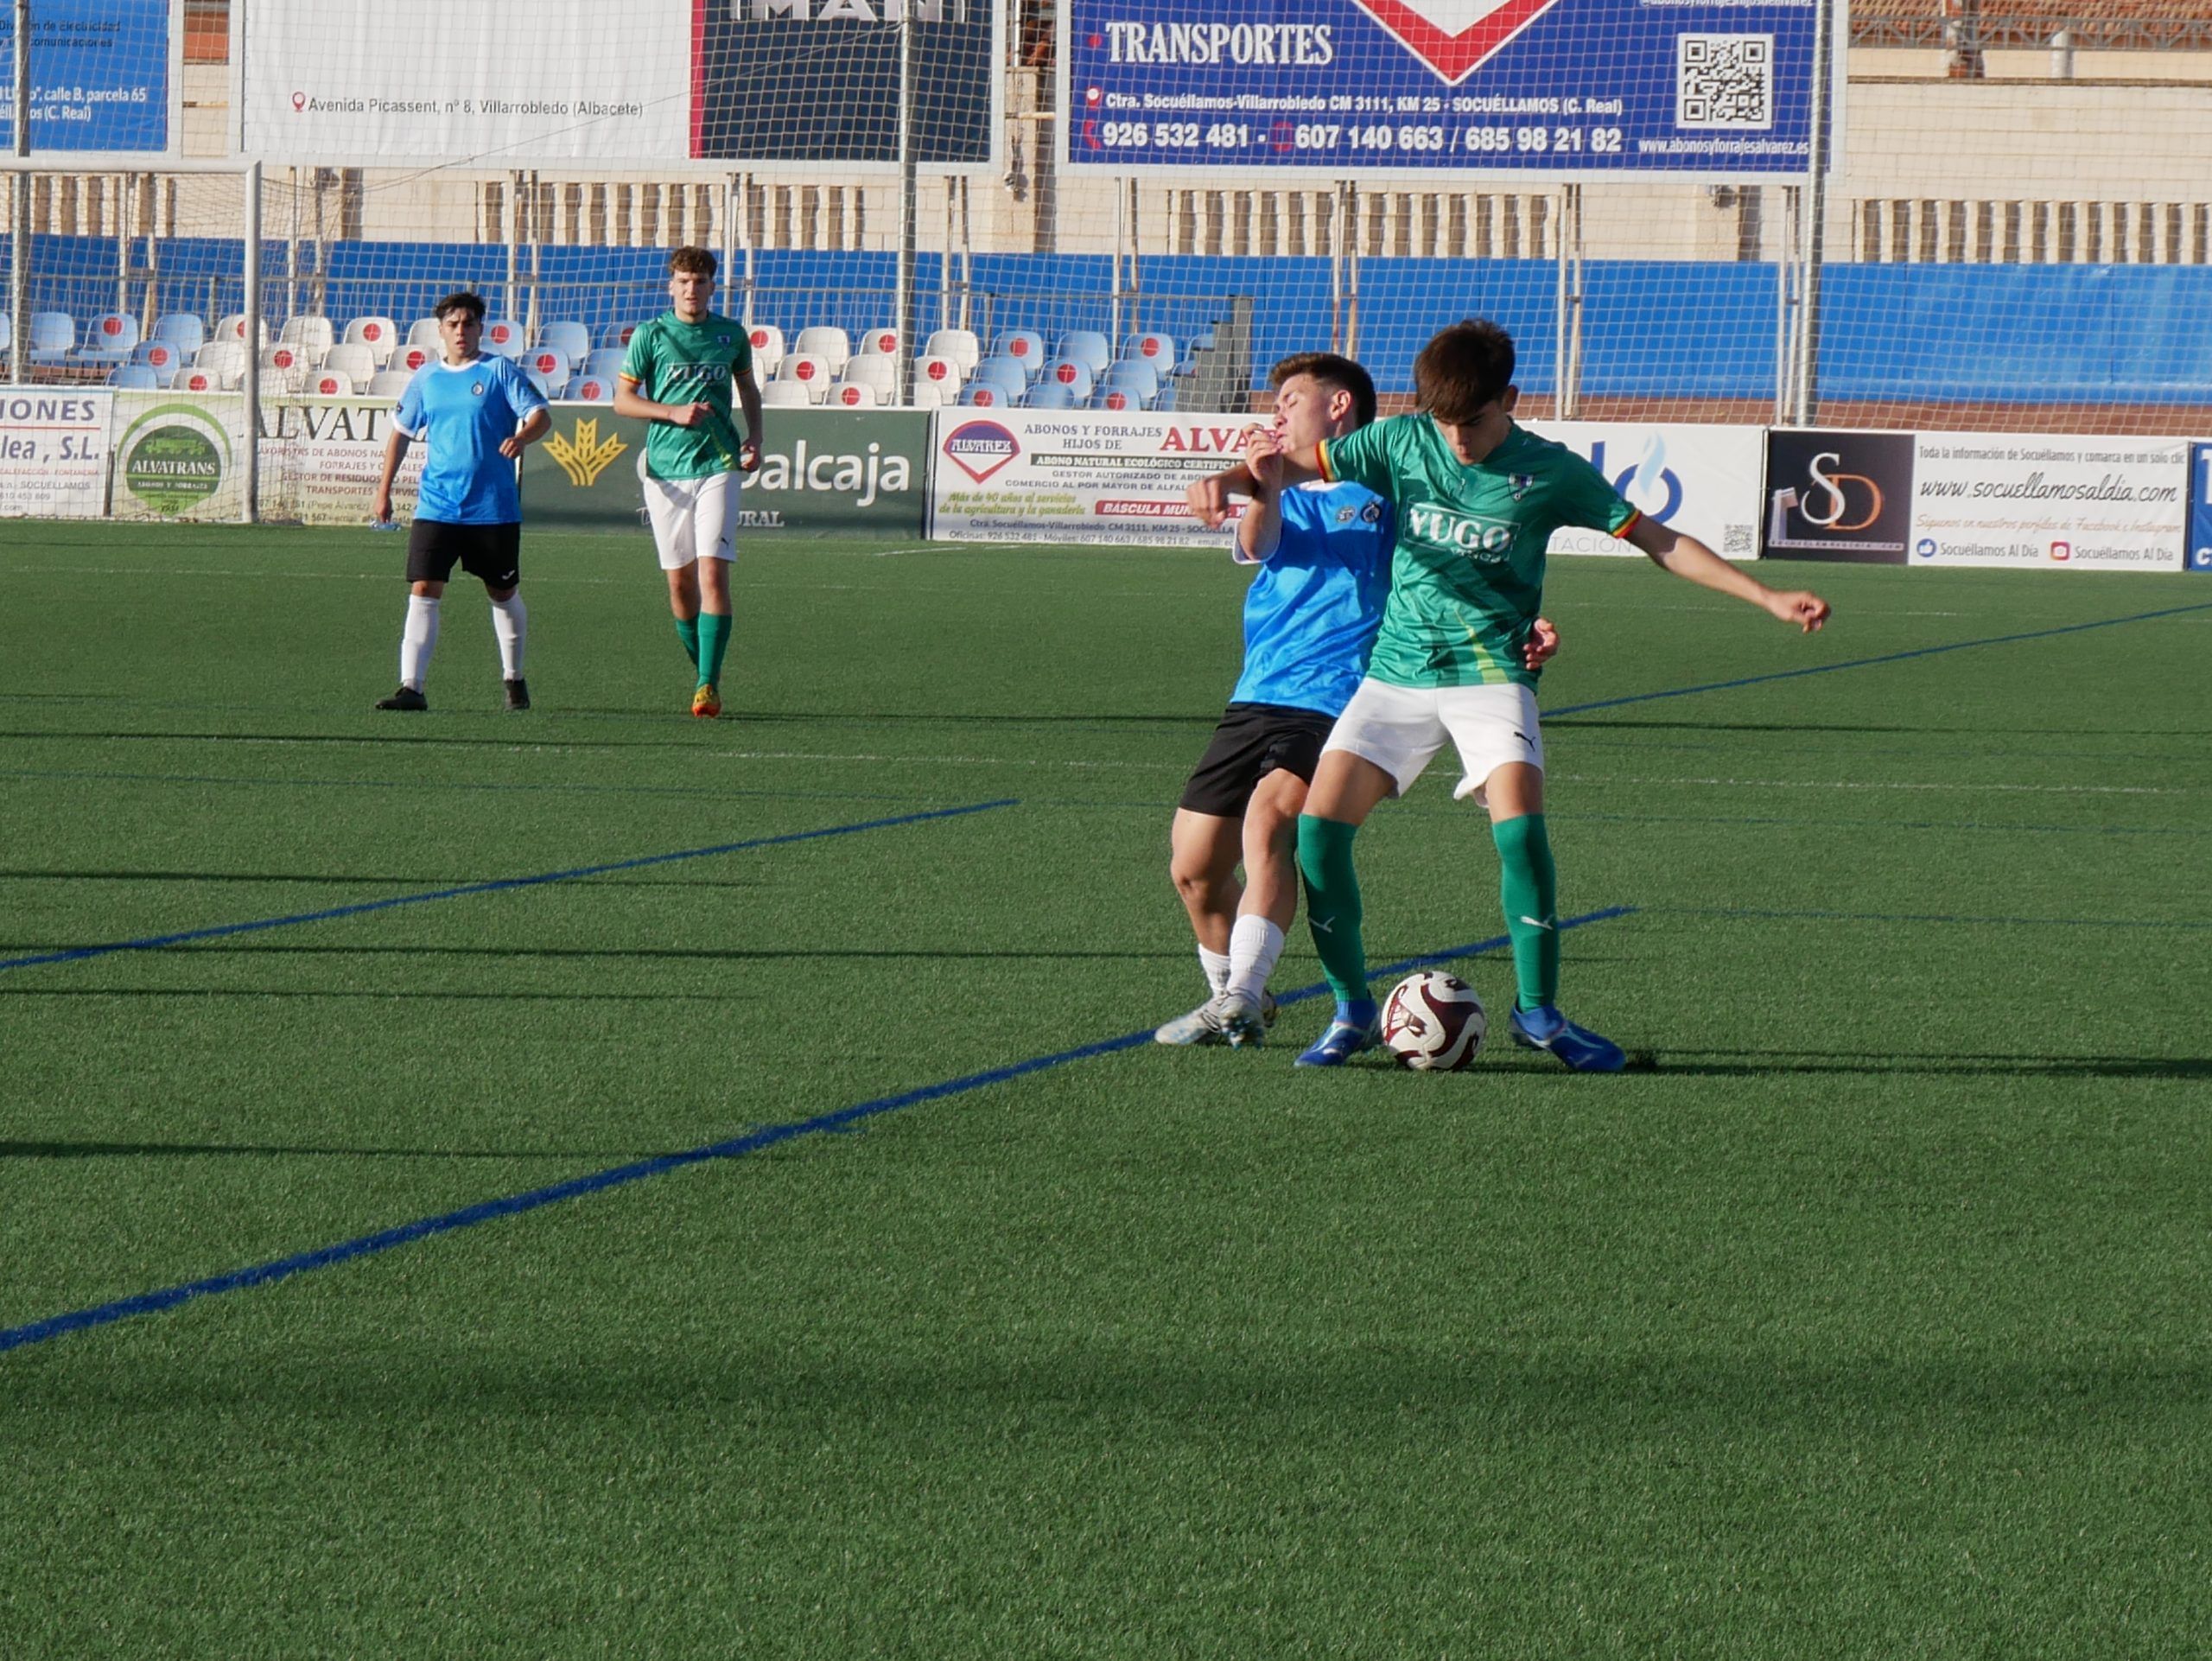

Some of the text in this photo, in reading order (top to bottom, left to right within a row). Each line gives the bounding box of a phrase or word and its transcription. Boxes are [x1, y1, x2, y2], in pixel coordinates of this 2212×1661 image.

[44, 20, 121, 32] de Electricidad
[1105, 22, 1333, 65] TRANSPORTES
[44, 87, 146, 104] calle B, parcela 65
[308, 97, 644, 118] Avenida Picassent, nº 8, Villarrobledo (Albacete)
[1105, 92, 1623, 116] Ctra. Socuéllamos-Villarrobledo CM 3111, KM 25 SOCUÉLLAMOS (C. Real)
[44, 105, 60, 122] (C.
[61, 105, 92, 122] Real)
[1103, 122, 1148, 147] 926
[1154, 123, 1199, 147] 532
[1205, 123, 1249, 148] 481
[1295, 124, 1340, 149] 607
[1348, 125, 1392, 150] 140
[1398, 125, 1443, 150] 663
[1448, 125, 1461, 153] /
[1465, 125, 1510, 151] 685
[1516, 126, 1548, 151] 98
[1554, 127, 1582, 152] 21
[1591, 127, 1622, 152] 82
[1638, 137, 1809, 156] www.abonosyforrajesalvarez.es
[1024, 423, 1163, 438] ABONOS Y FORRAJES
[60, 435, 100, 461] S.L.
[1063, 438, 1122, 450] HIJOS DE
[312, 448, 325, 457] DE
[327, 448, 367, 458] ABONOS
[1919, 445, 2185, 465] Toda la información de Socuéllamos y comarca en un solo clic
[131, 460, 215, 475] ALVATRANS
[320, 461, 367, 471] FORRAJES
[1037, 455, 1073, 466] ABONO
[1073, 455, 1123, 468] NATURAL
[1124, 455, 1182, 468] ECOLÓGICO
[321, 473, 333, 481] DE
[335, 474, 382, 483] RESIDUOS
[1052, 470, 1093, 479] GESTOR
[1096, 471, 1161, 480] AUTORIZADO
[307, 486, 373, 496] TRANSPORTES
[1005, 480, 1059, 488] COMERCIO
[1062, 480, 1075, 489] AL
[1077, 481, 1100, 490] POR
[1102, 481, 1138, 491] MAYOR
[1141, 482, 1154, 491] DE
[972, 492, 983, 501] de
[939, 503, 950, 513] de
[964, 503, 1016, 517] agricultura
[1103, 501, 1160, 515] BÁSCULA
[1108, 523, 1124, 531] CM
[1152, 524, 1168, 532] KM
[1410, 506, 1510, 553] YUGO
[1940, 543, 2006, 557] Socuéllamos
[2008, 544, 2018, 557] Al
[2075, 546, 2140, 560] Socuéllamos
[2144, 547, 2155, 560] Al
